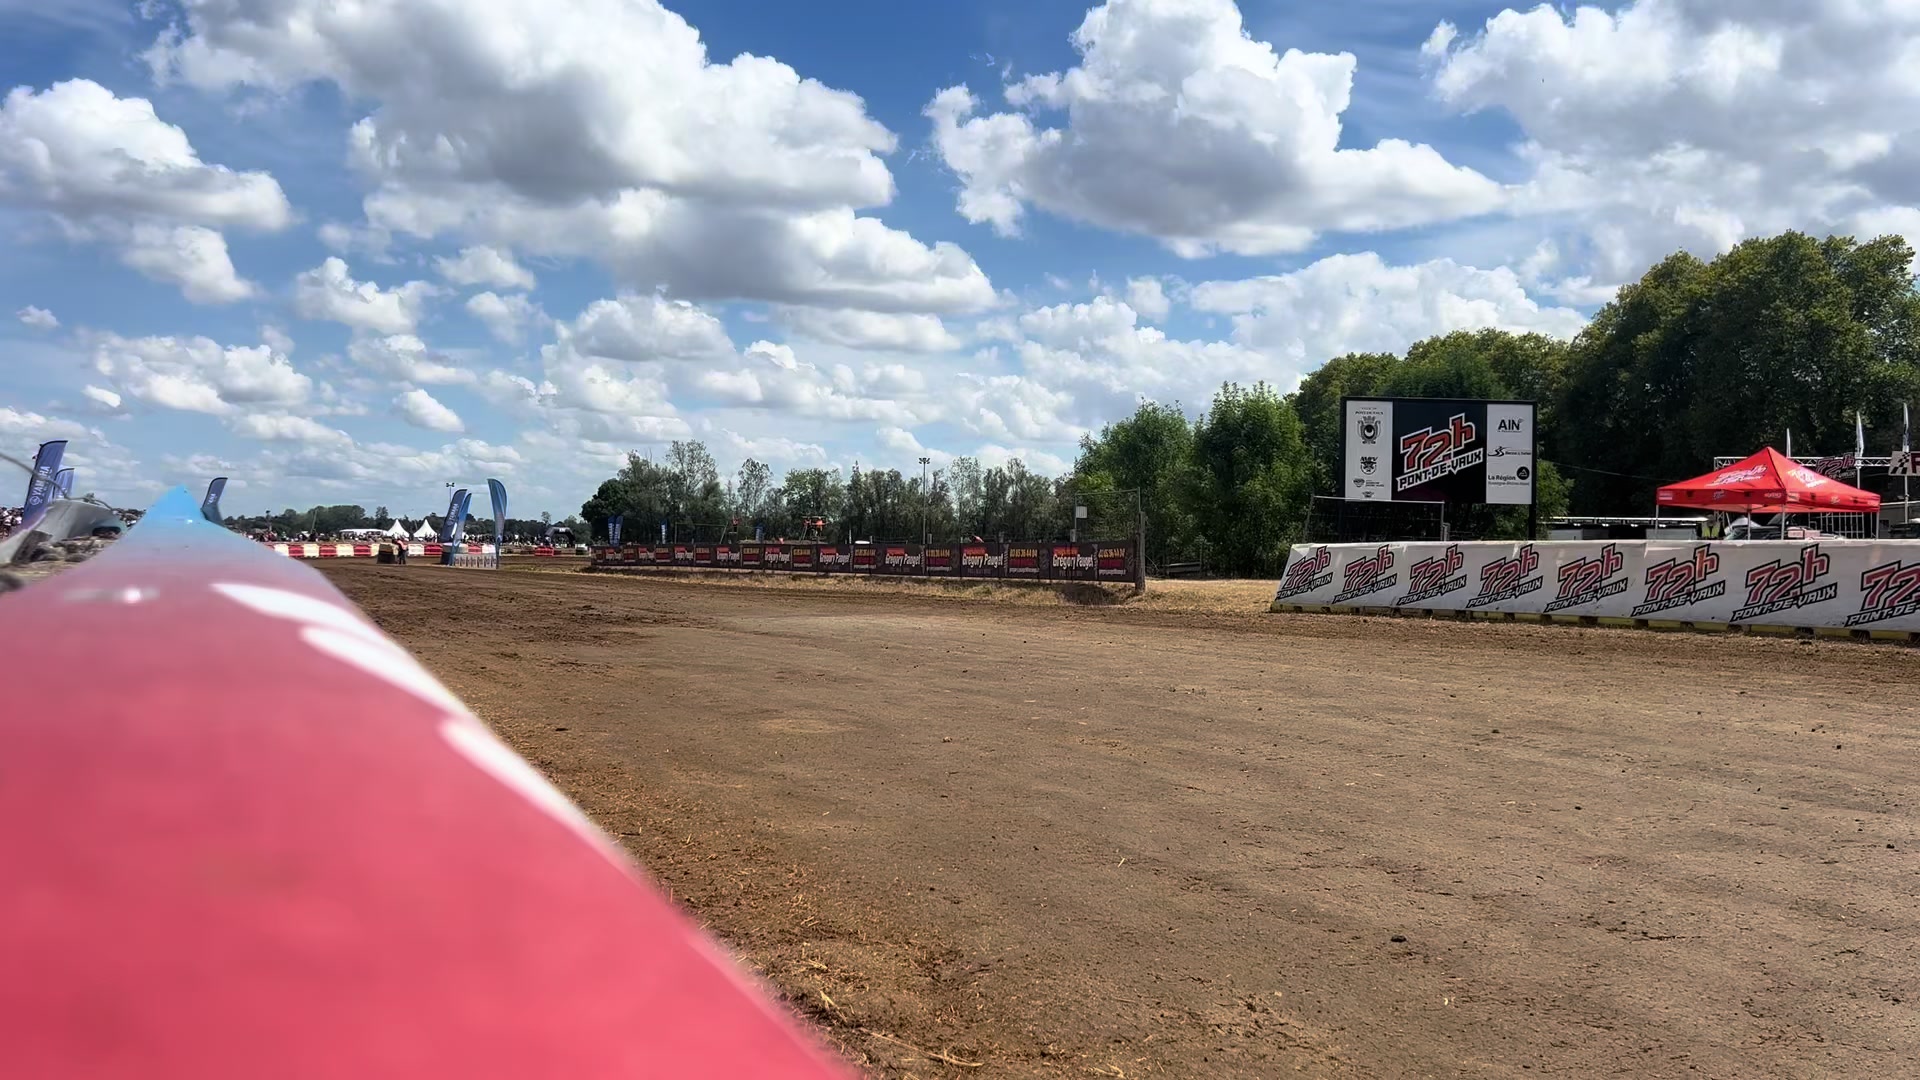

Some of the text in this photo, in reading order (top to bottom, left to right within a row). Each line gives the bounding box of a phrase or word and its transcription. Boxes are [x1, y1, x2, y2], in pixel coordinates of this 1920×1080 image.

[1400, 413, 1475, 473] 72h
[1498, 419, 1520, 430] AIN
[32, 466, 51, 496] YAMHA
[1398, 449, 1482, 490] PONT-DE-VAUX
[1276, 573, 1333, 600] PONT-DE-VAUX
[1282, 545, 1331, 590] 72h
[1342, 544, 1394, 592] 72h
[1409, 544, 1464, 594] 72h
[1478, 544, 1539, 596] 72h
[1557, 543, 1623, 599] 72h
[1645, 543, 1719, 602] 72h
[1744, 543, 1829, 607] 72h
[1333, 574, 1397, 603] PONT-DE-VAUX
[1399, 575, 1467, 604] PONT-DE-VAUX
[1467, 576, 1543, 608] PONT-DE-VAUX
[1545, 578, 1628, 612] PONT-DE-VAUX
[1631, 580, 1725, 616] PONT-DE-VAUX
[1731, 583, 1837, 622] PONT-DE-VAUX
